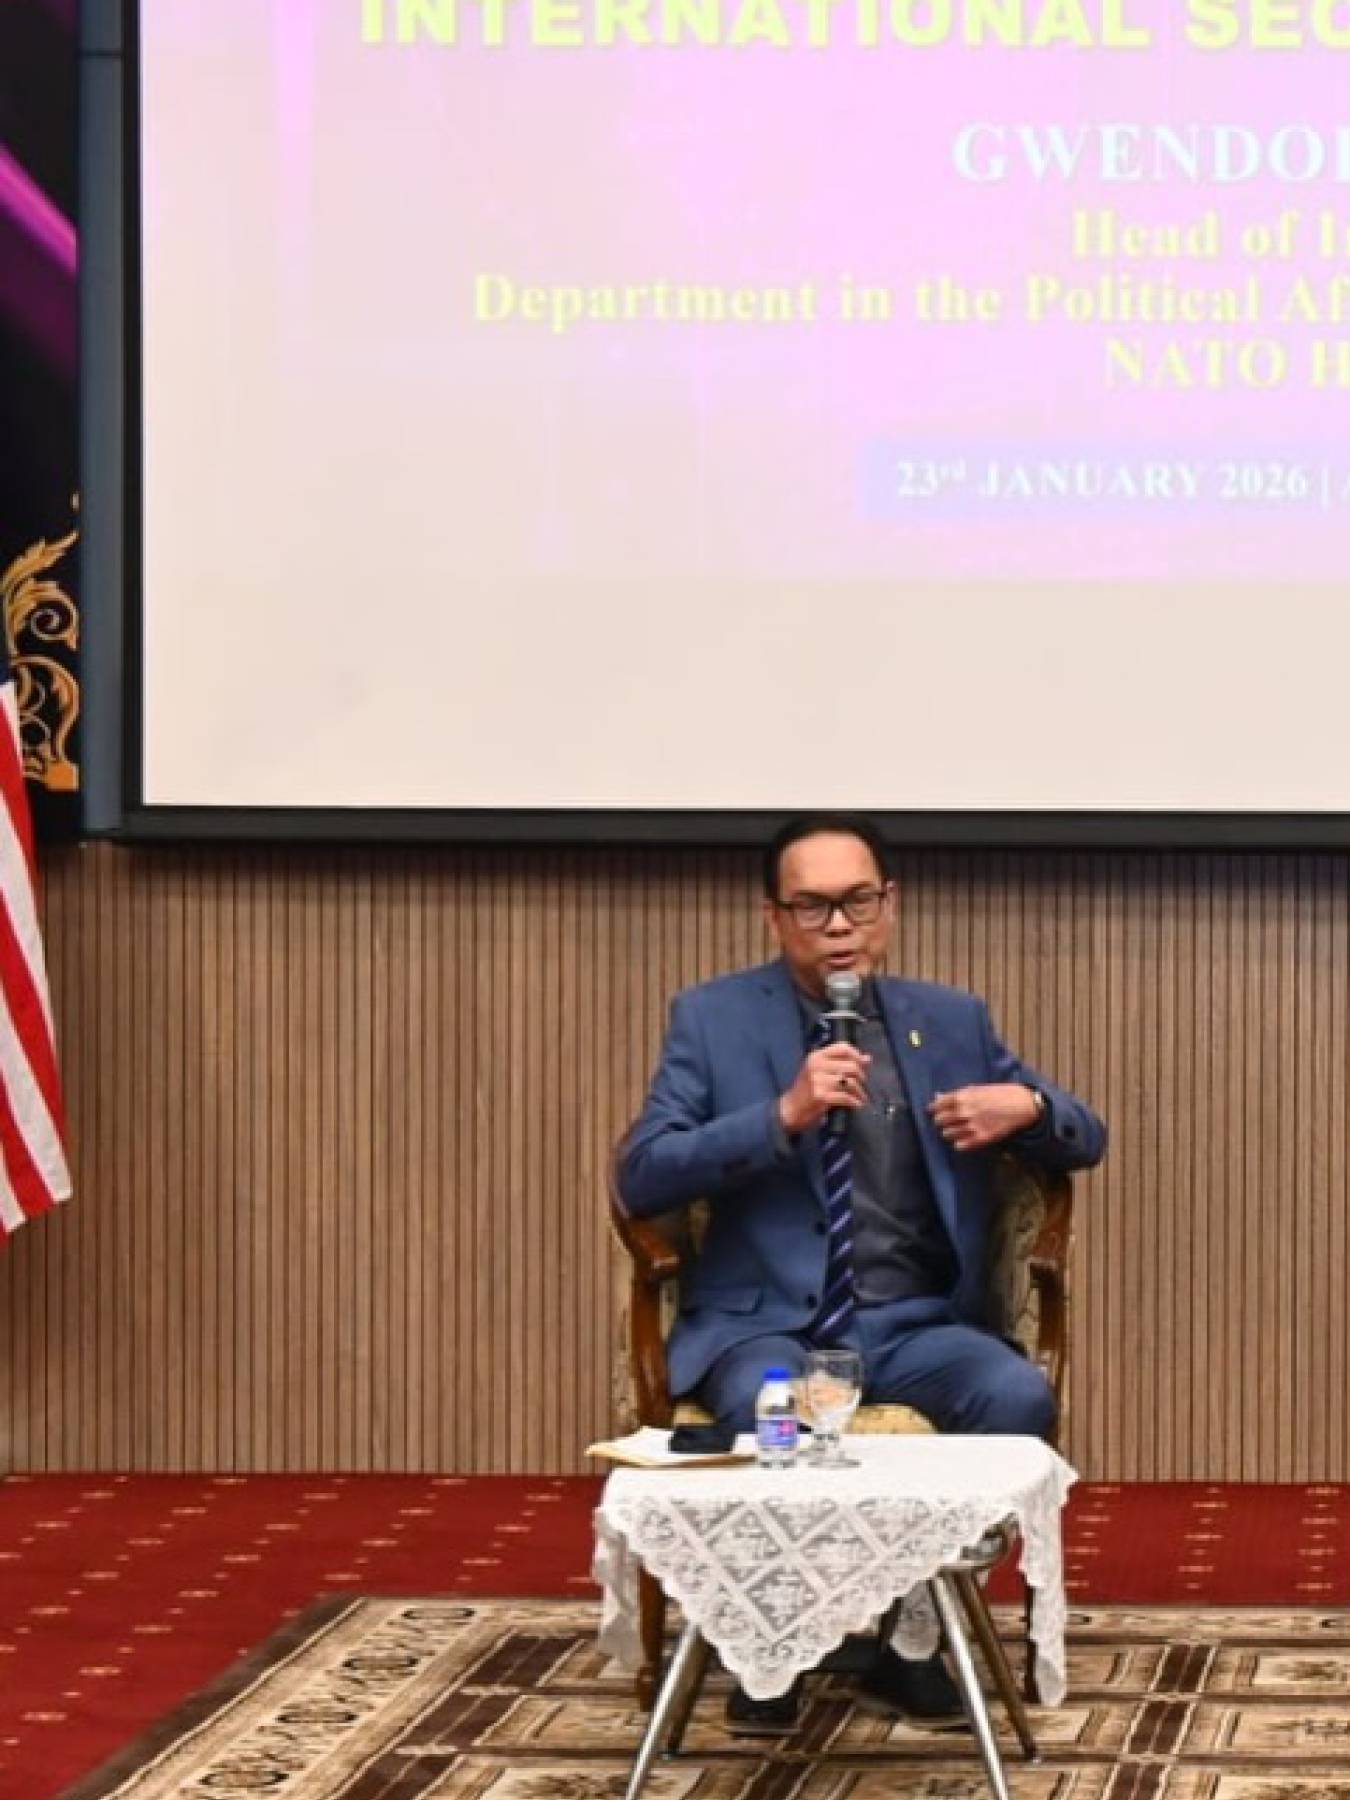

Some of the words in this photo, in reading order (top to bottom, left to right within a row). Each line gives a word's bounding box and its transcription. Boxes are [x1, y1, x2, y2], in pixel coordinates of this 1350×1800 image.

[360, 0, 1152, 48] INTERNATIONAL
[1072, 208, 1218, 259] Head
[1241, 208, 1301, 259] of
[472, 273, 819, 334] Department
[839, 273, 892, 323] in
[914, 273, 1003, 323] the
[1025, 275, 1260, 325] Political
[1104, 339, 1286, 390] NATO
[896, 458, 967, 498] 23rd
[978, 461, 1203, 500] JANUARY
[1219, 463, 1309, 500] 2026
